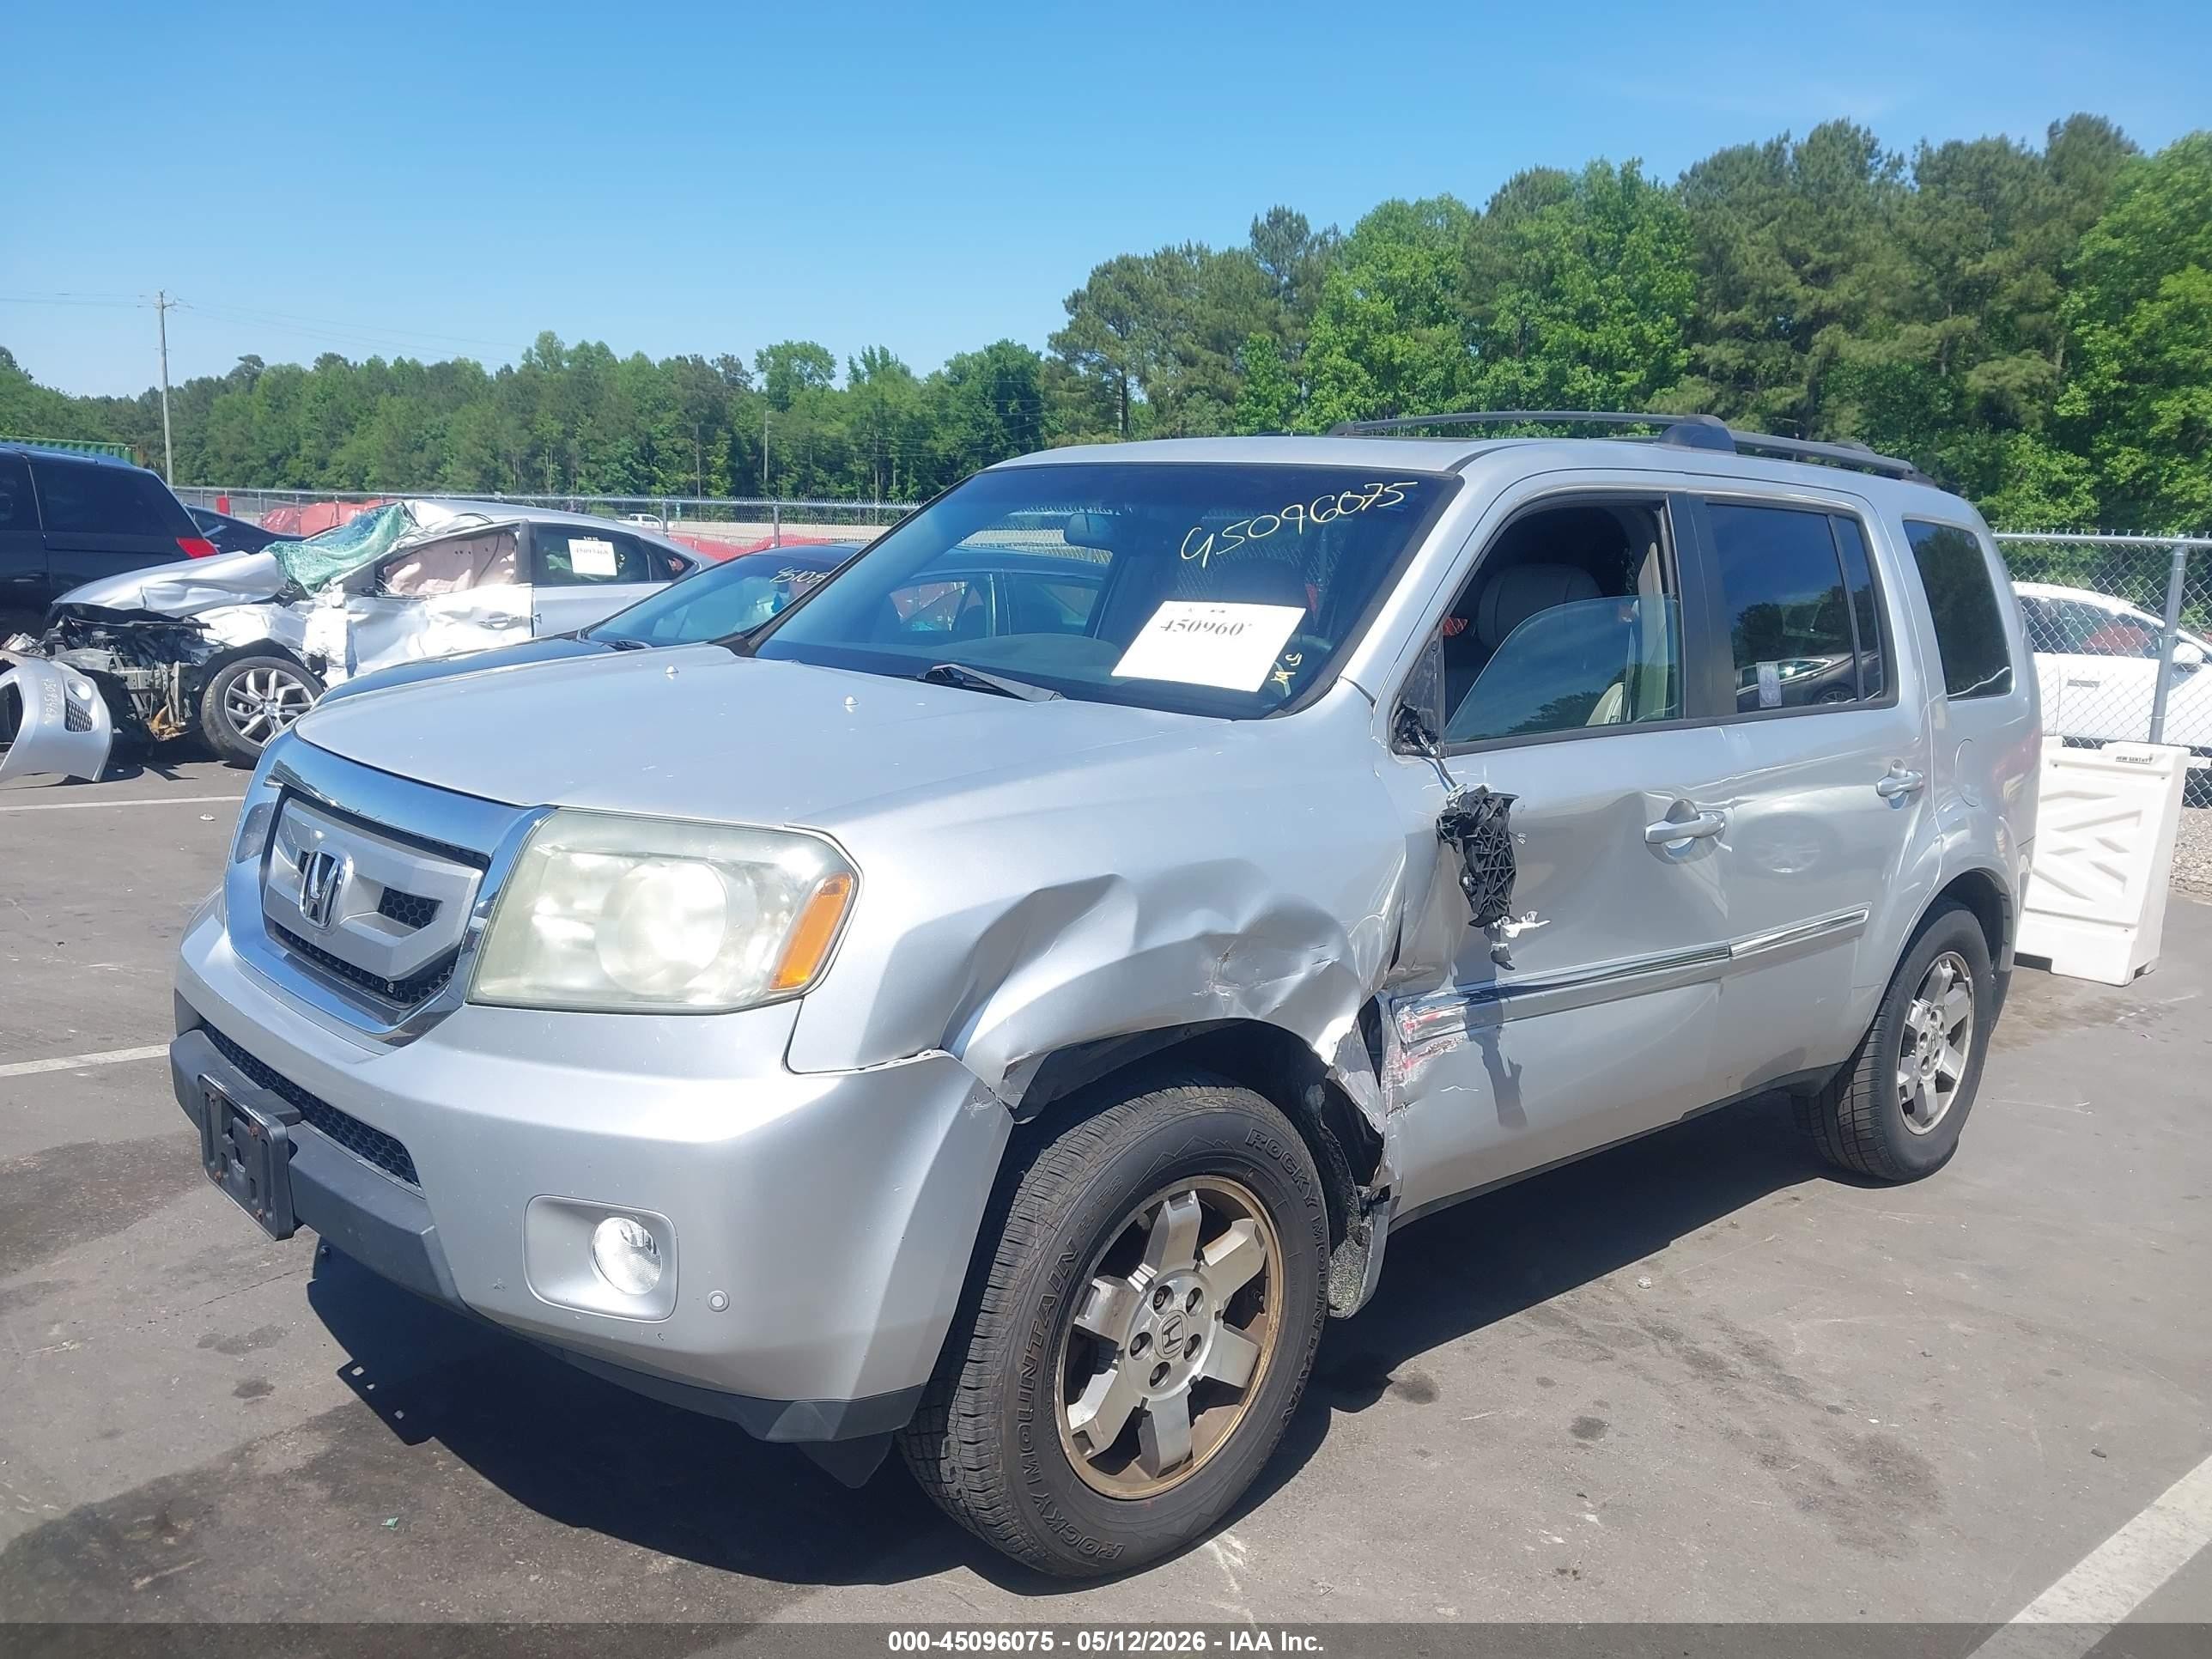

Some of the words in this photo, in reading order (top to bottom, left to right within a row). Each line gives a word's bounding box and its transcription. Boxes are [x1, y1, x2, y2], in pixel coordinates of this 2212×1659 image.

[1181, 482, 1418, 568] 45096075
[1160, 618, 1253, 637] 450960
[1245, 1127, 1319, 1208] ROCKY
[1018, 1237, 1079, 1485] MOUNTAIN
[1030, 1492, 1126, 1559] ROCKY
